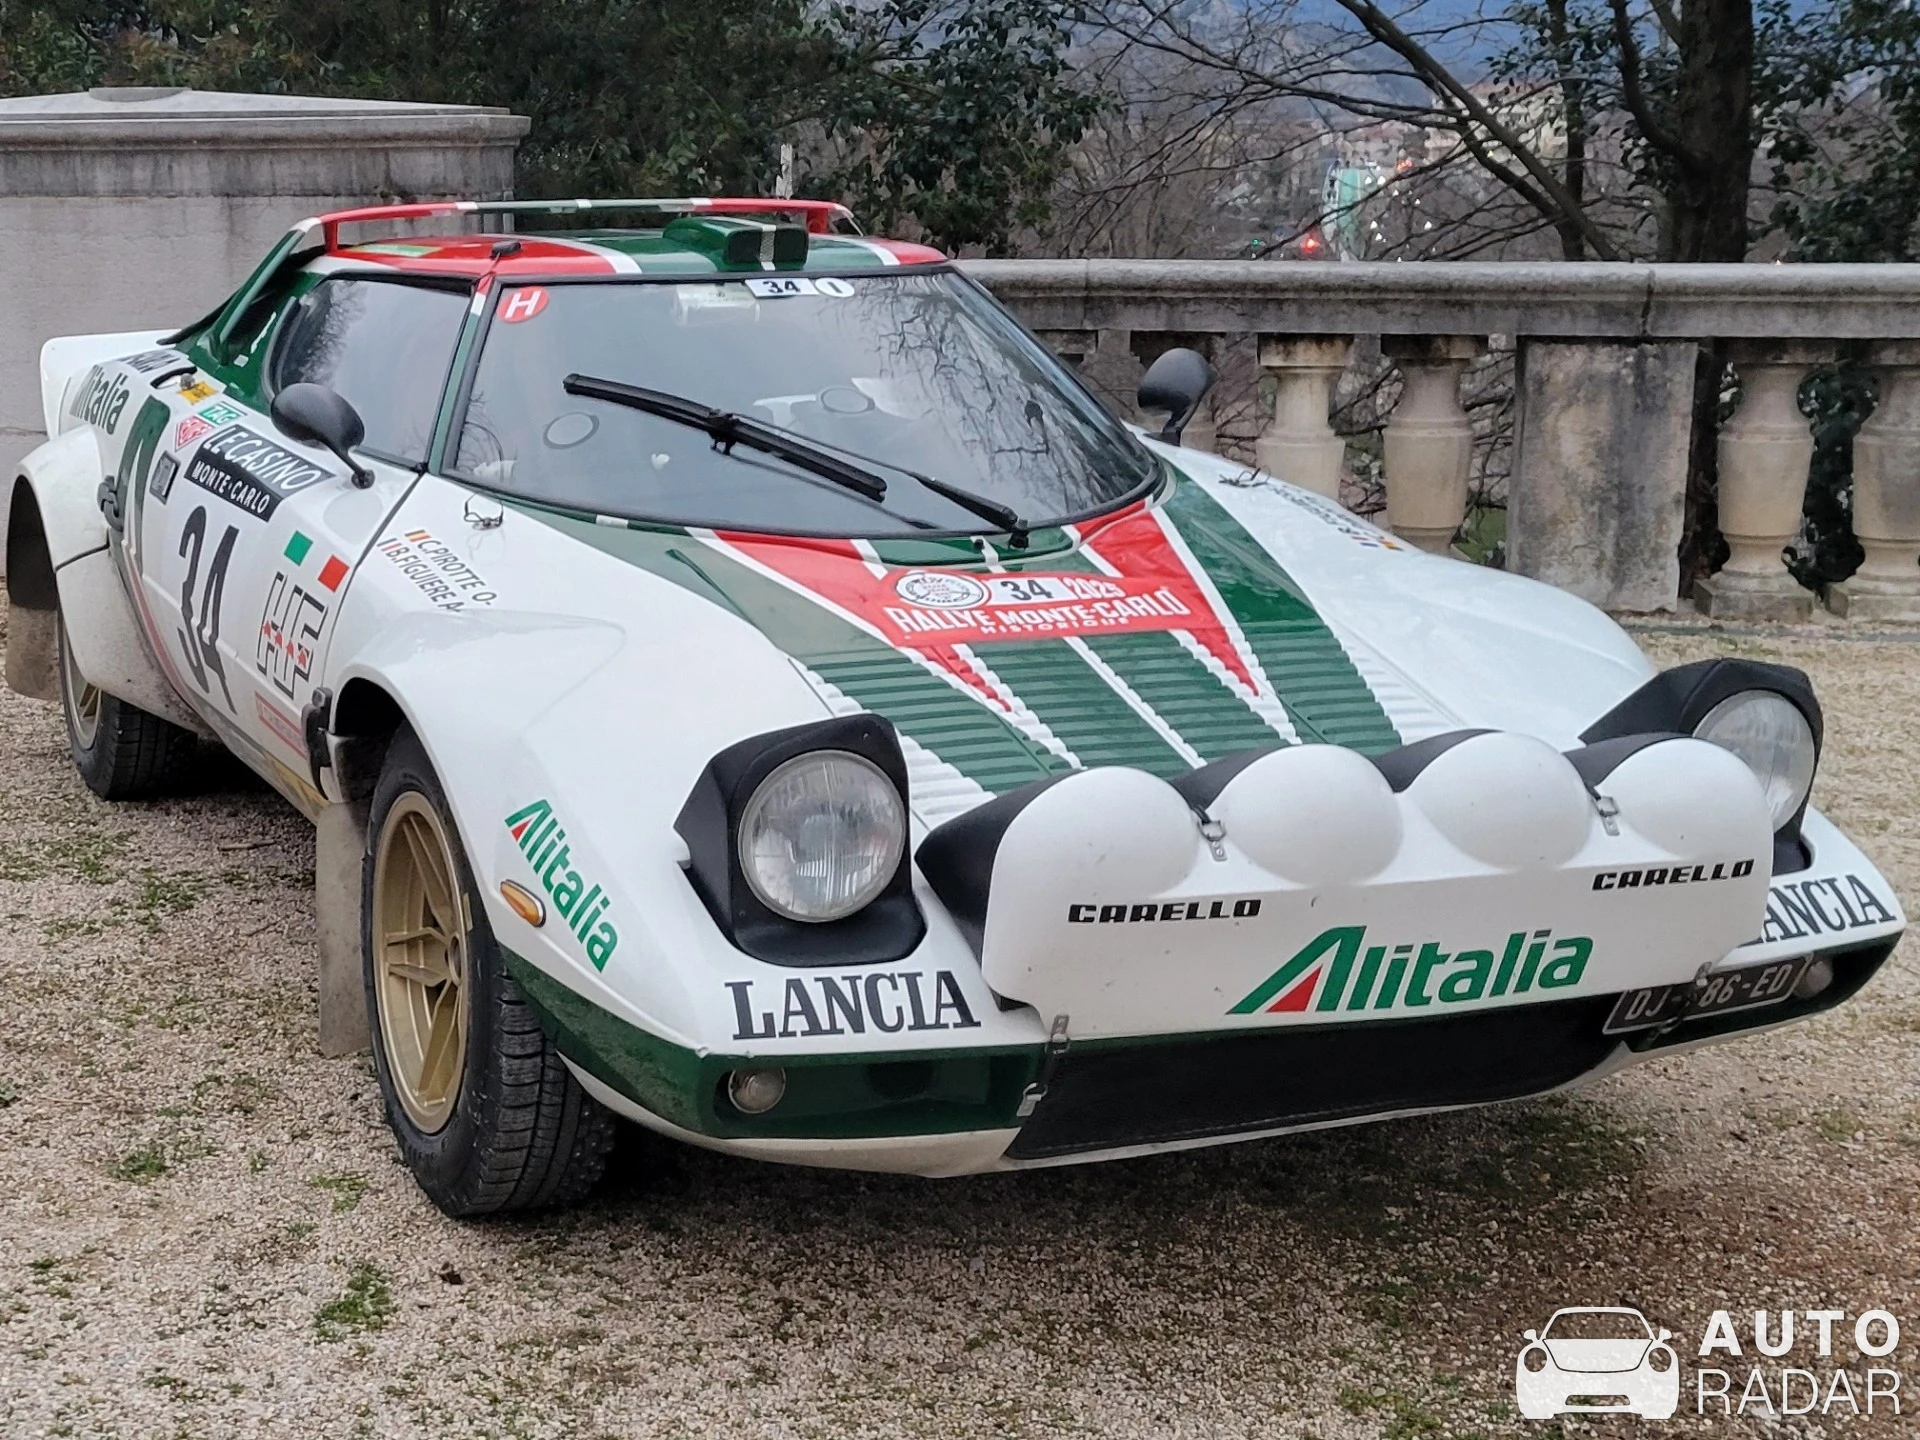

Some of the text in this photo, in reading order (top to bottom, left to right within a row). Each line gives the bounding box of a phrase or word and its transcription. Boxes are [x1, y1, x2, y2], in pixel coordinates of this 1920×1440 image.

[505, 291, 541, 318] H
[763, 281, 800, 293] 34
[203, 405, 237, 423] TAG
[386, 546, 457, 602] B.FIGUIERE
[417, 540, 486, 590] C.PIROTTE
[177, 506, 239, 715] 34
[884, 606, 995, 633] RALLYE
[995, 590, 1191, 626] MONTE-CARLO
[1001, 577, 1126, 601] 34 2025
[981, 616, 1129, 634] HISTORIQUE
[504, 799, 618, 973] Alitalia
[1592, 858, 1755, 890] CARELLO
[1068, 899, 1262, 923] CARELLO
[1739, 874, 1897, 947] ANCIA
[1225, 925, 1594, 1015] Alitalia
[1624, 964, 1792, 1020] DJ-86-ED
[725, 970, 981, 1041] LANCIA
